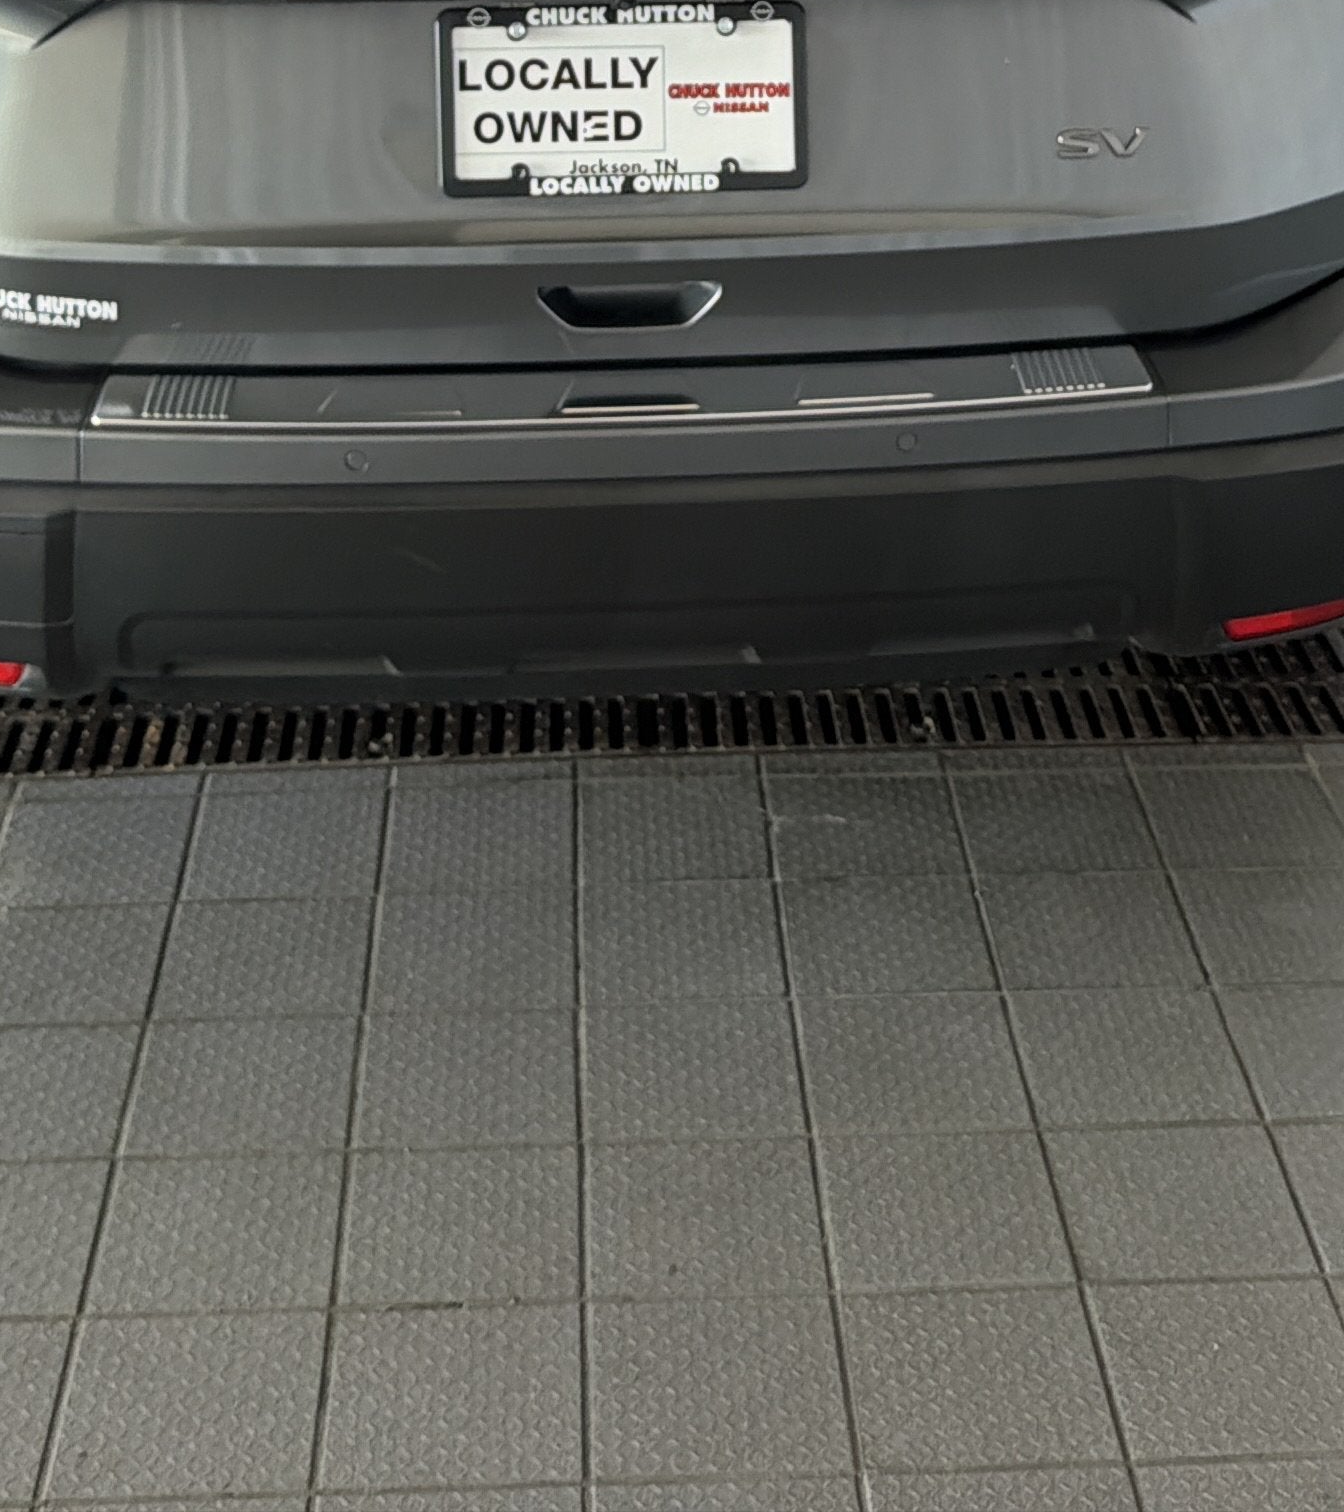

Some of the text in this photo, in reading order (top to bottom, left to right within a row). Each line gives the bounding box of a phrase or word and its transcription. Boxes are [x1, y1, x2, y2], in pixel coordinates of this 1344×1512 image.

[526, 4, 715, 26] CHUCK HUTTON
[458, 56, 659, 92] LOCALLY
[668, 82, 790, 99] CHUCK HUTTON
[713, 101, 769, 113] NISSAN
[473, 110, 643, 144] OWNED
[1056, 127, 1149, 159] SV
[569, 158, 678, 175] Jackson, TN
[529, 173, 720, 196] LOCALLY OWNED
[1, 308, 81, 328] NISSAN
[36, 294, 118, 322] HUTTON
